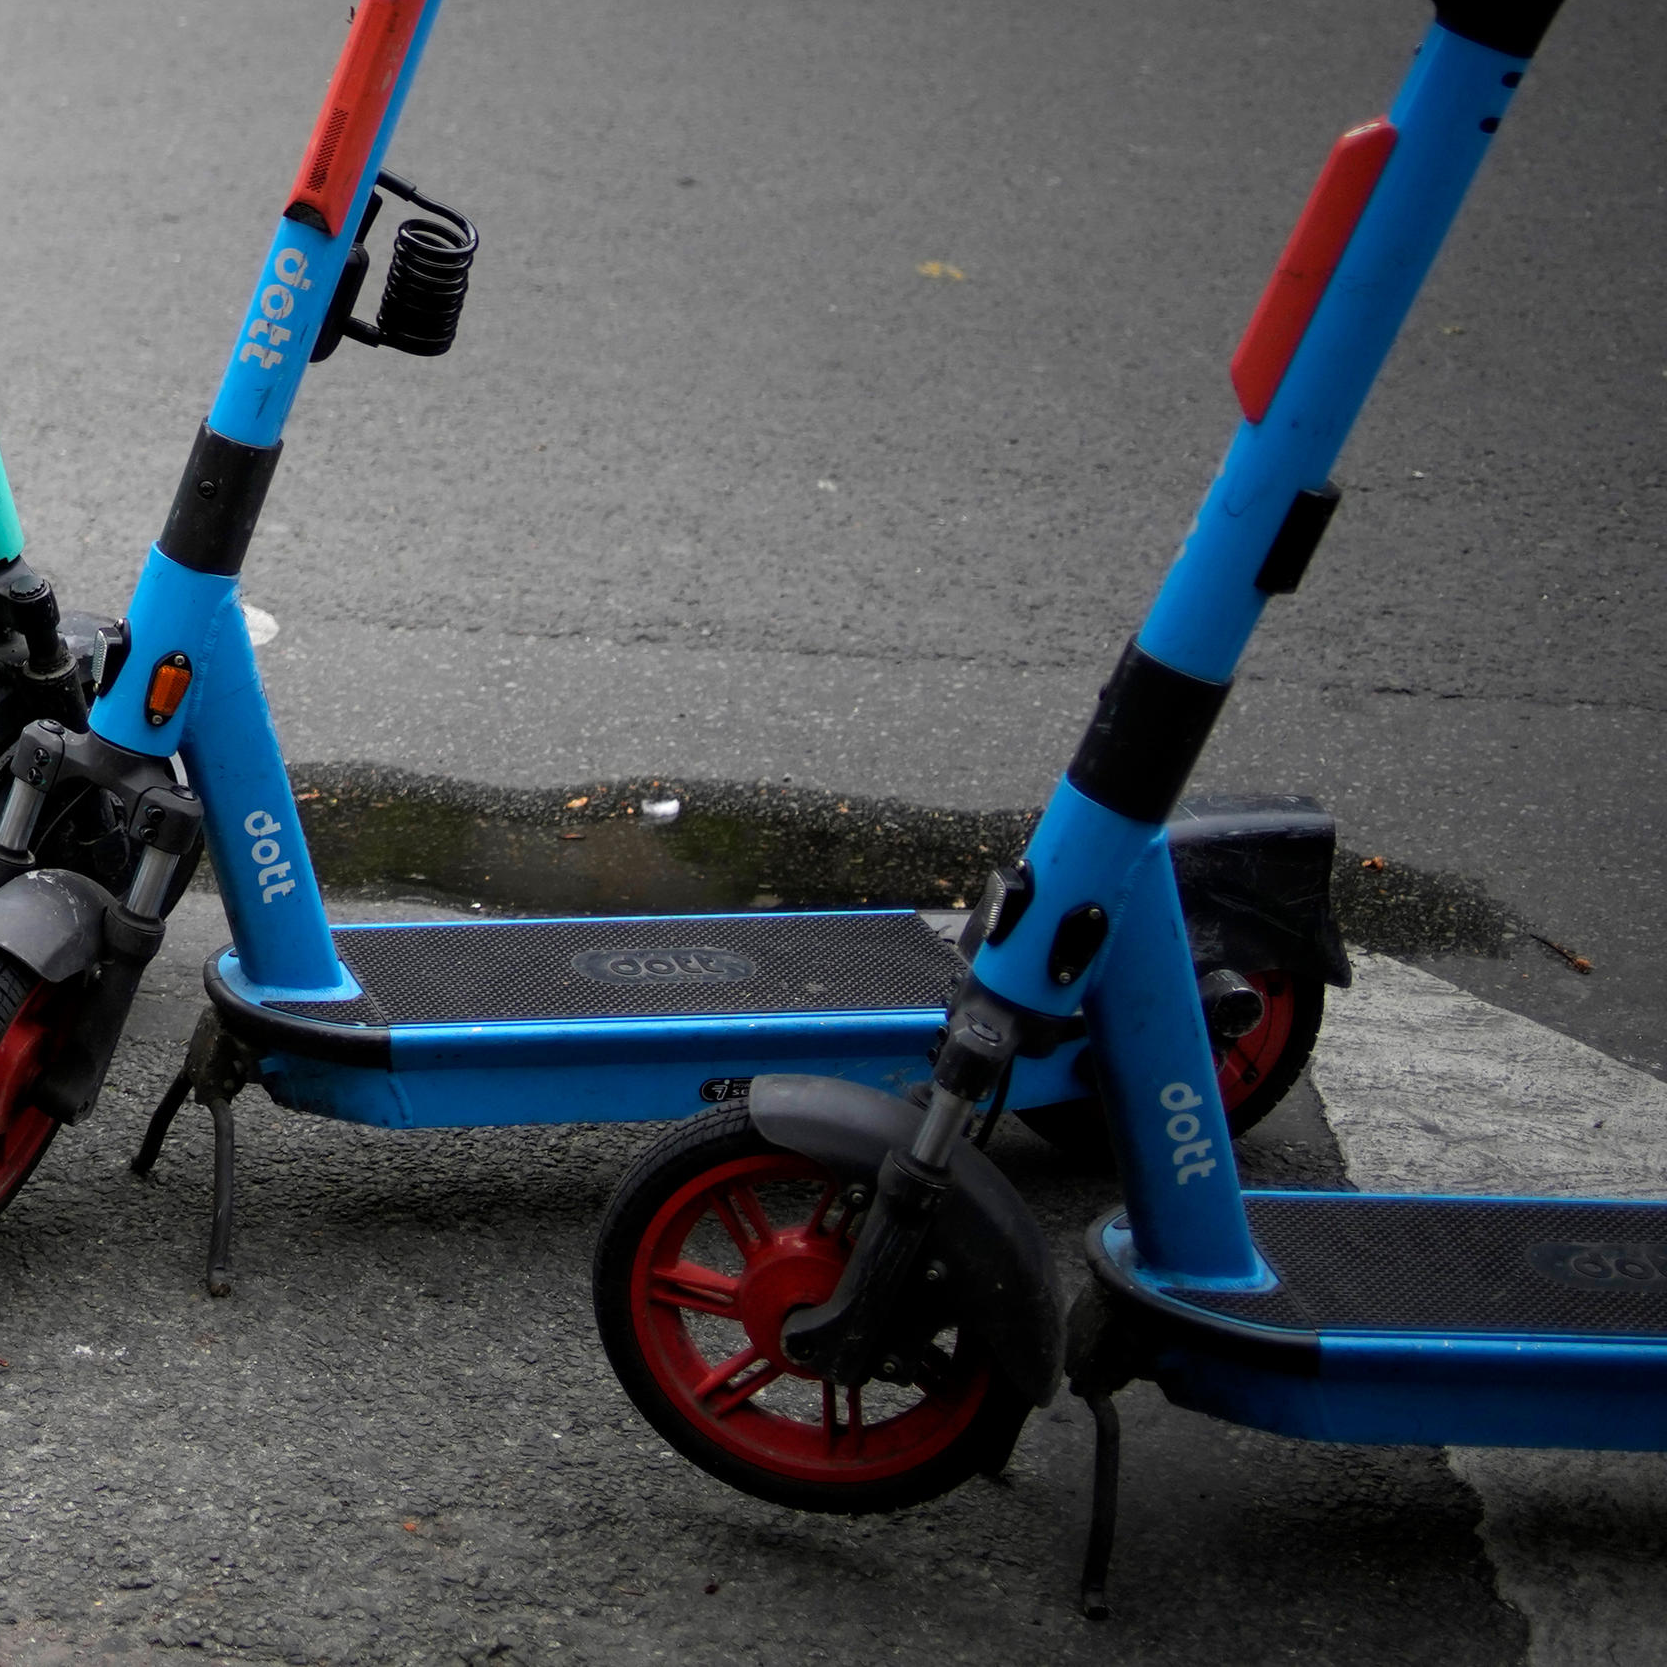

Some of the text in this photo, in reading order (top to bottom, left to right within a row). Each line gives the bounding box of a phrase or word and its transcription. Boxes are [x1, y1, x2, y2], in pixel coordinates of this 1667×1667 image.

[239, 247, 313, 370] dott
[244, 809, 297, 905] dott
[609, 953, 727, 976] dott
[1159, 1081, 1217, 1186] dott
